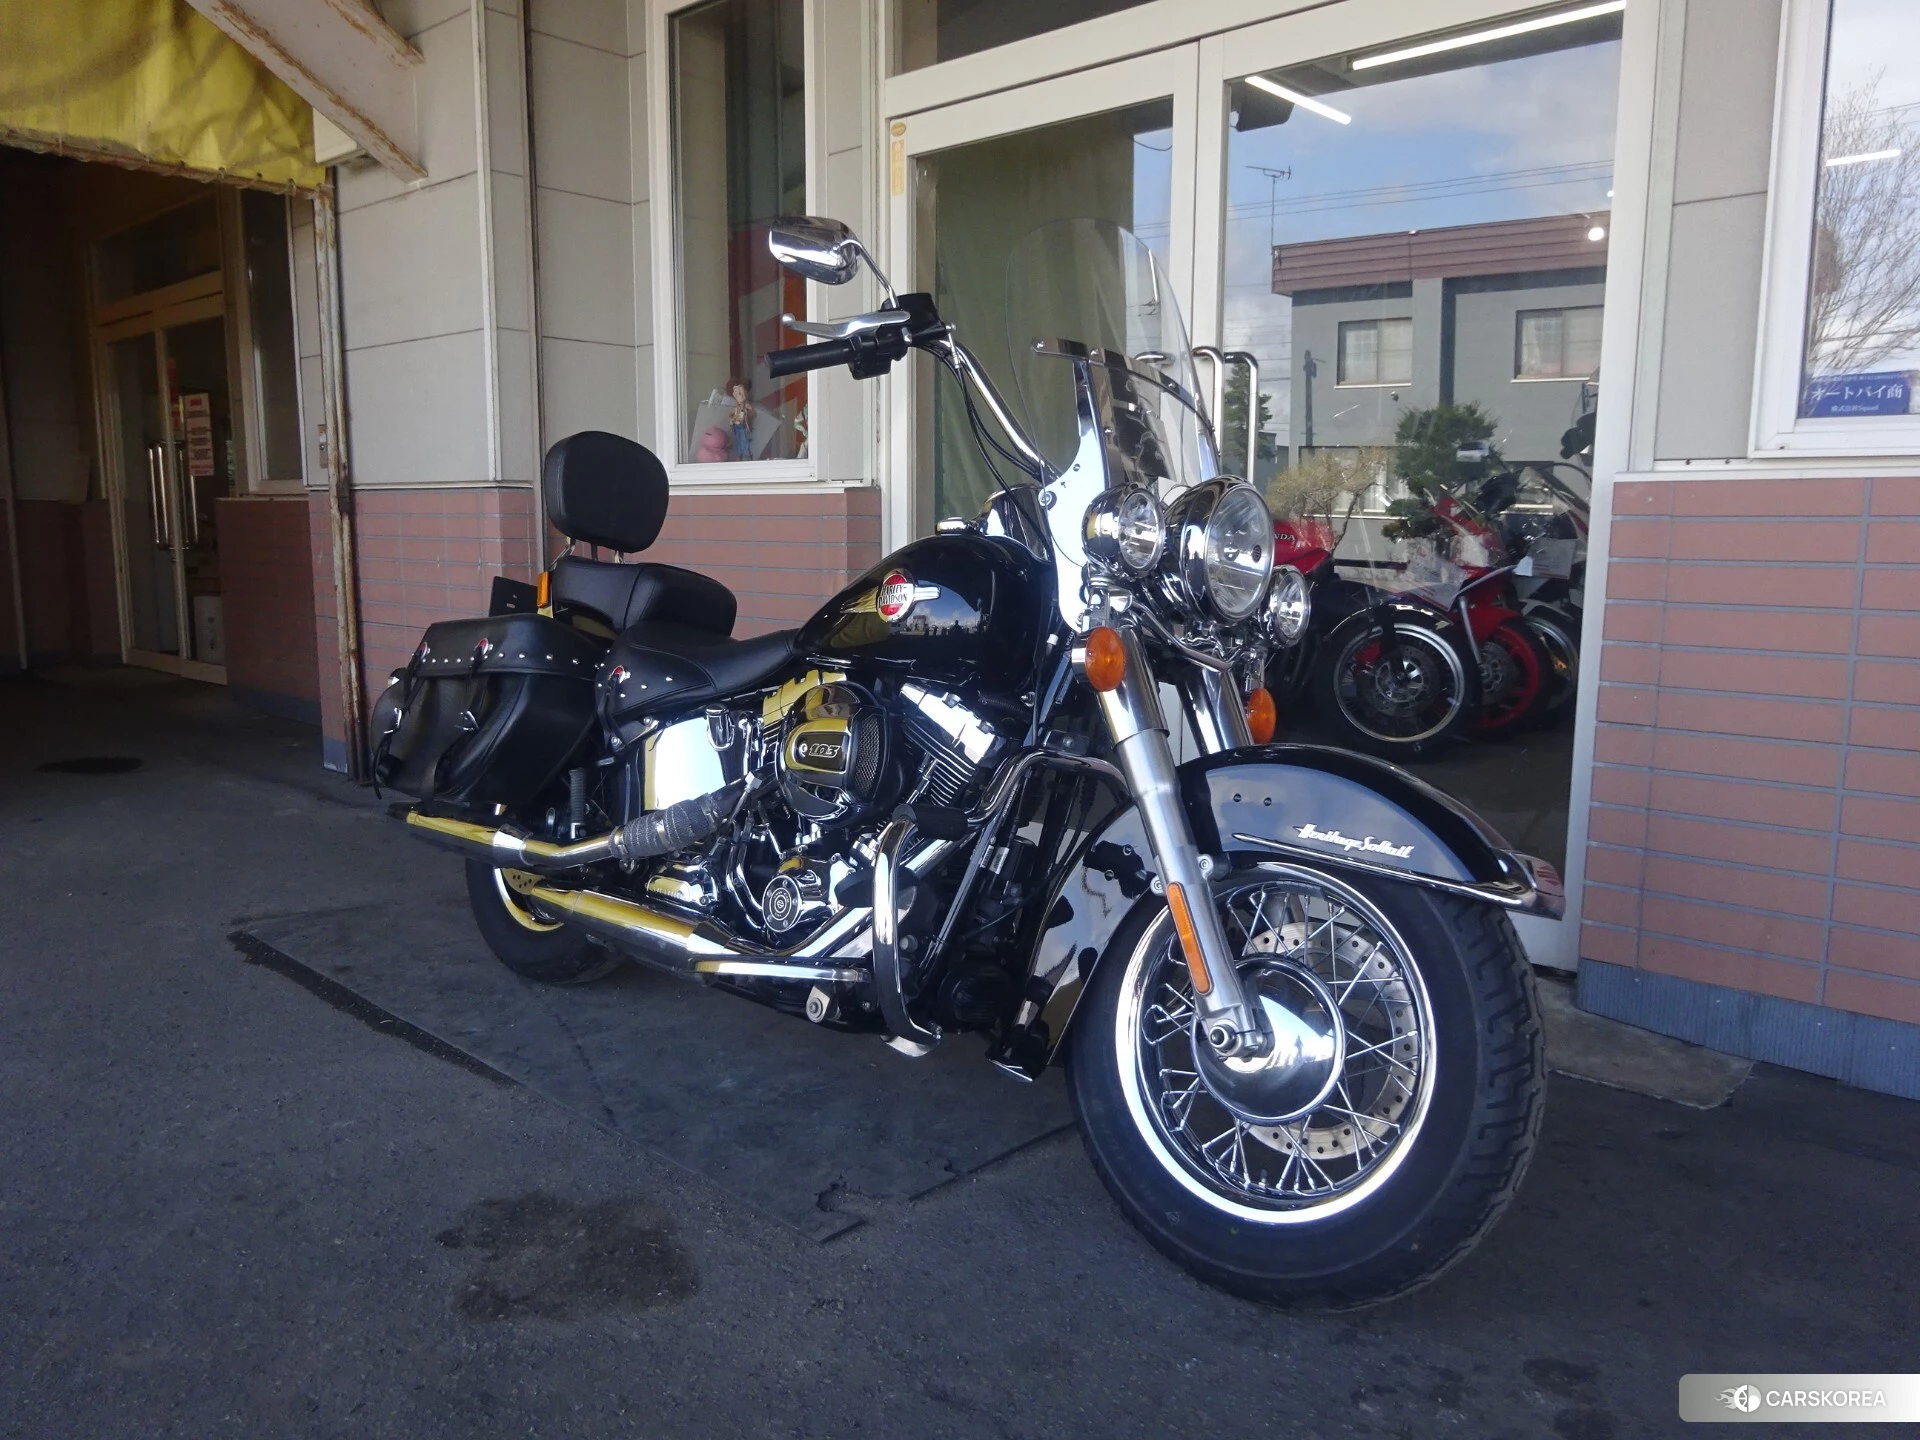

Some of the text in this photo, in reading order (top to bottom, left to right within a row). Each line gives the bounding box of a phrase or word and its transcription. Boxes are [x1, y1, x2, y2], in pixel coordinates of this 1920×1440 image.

[878, 593, 908, 608] DAVIDSON
[809, 743, 841, 759] 103
[1293, 823, 1415, 859] Heritage Softail
